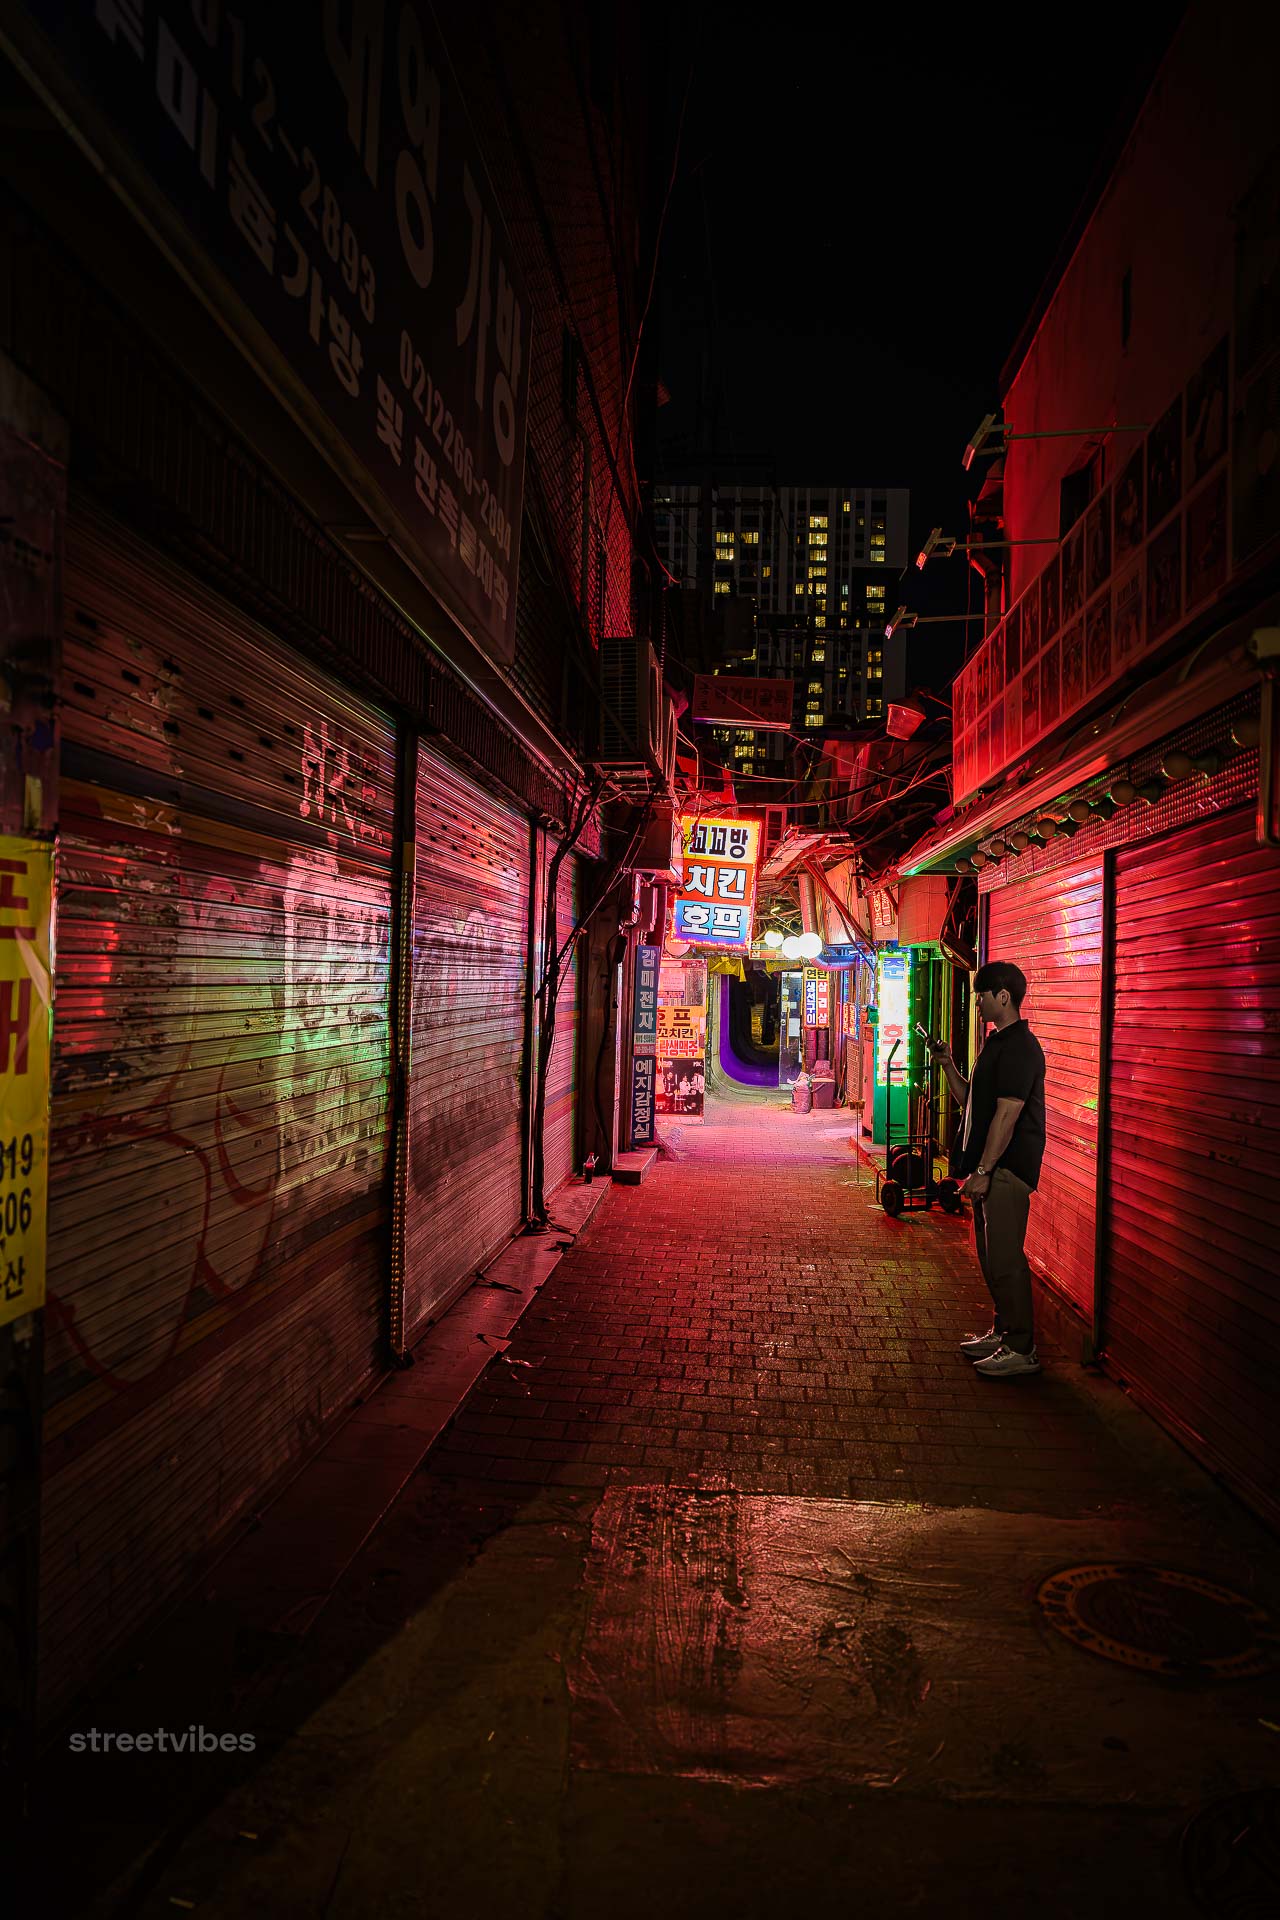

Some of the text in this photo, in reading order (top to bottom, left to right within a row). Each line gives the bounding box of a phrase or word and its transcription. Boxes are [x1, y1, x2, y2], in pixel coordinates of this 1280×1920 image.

[456, 160, 522, 467] 가방
[376, 372, 404, 467] 및
[414, 433, 509, 621] 판촉물제작
[689, 825, 749, 859] 꼬꼬방
[684, 865, 747, 900] 치킨
[681, 904, 742, 939] 호프
[806, 982, 816, 1024] 생선구이
[634, 1059, 653, 1140] 예지감정실
